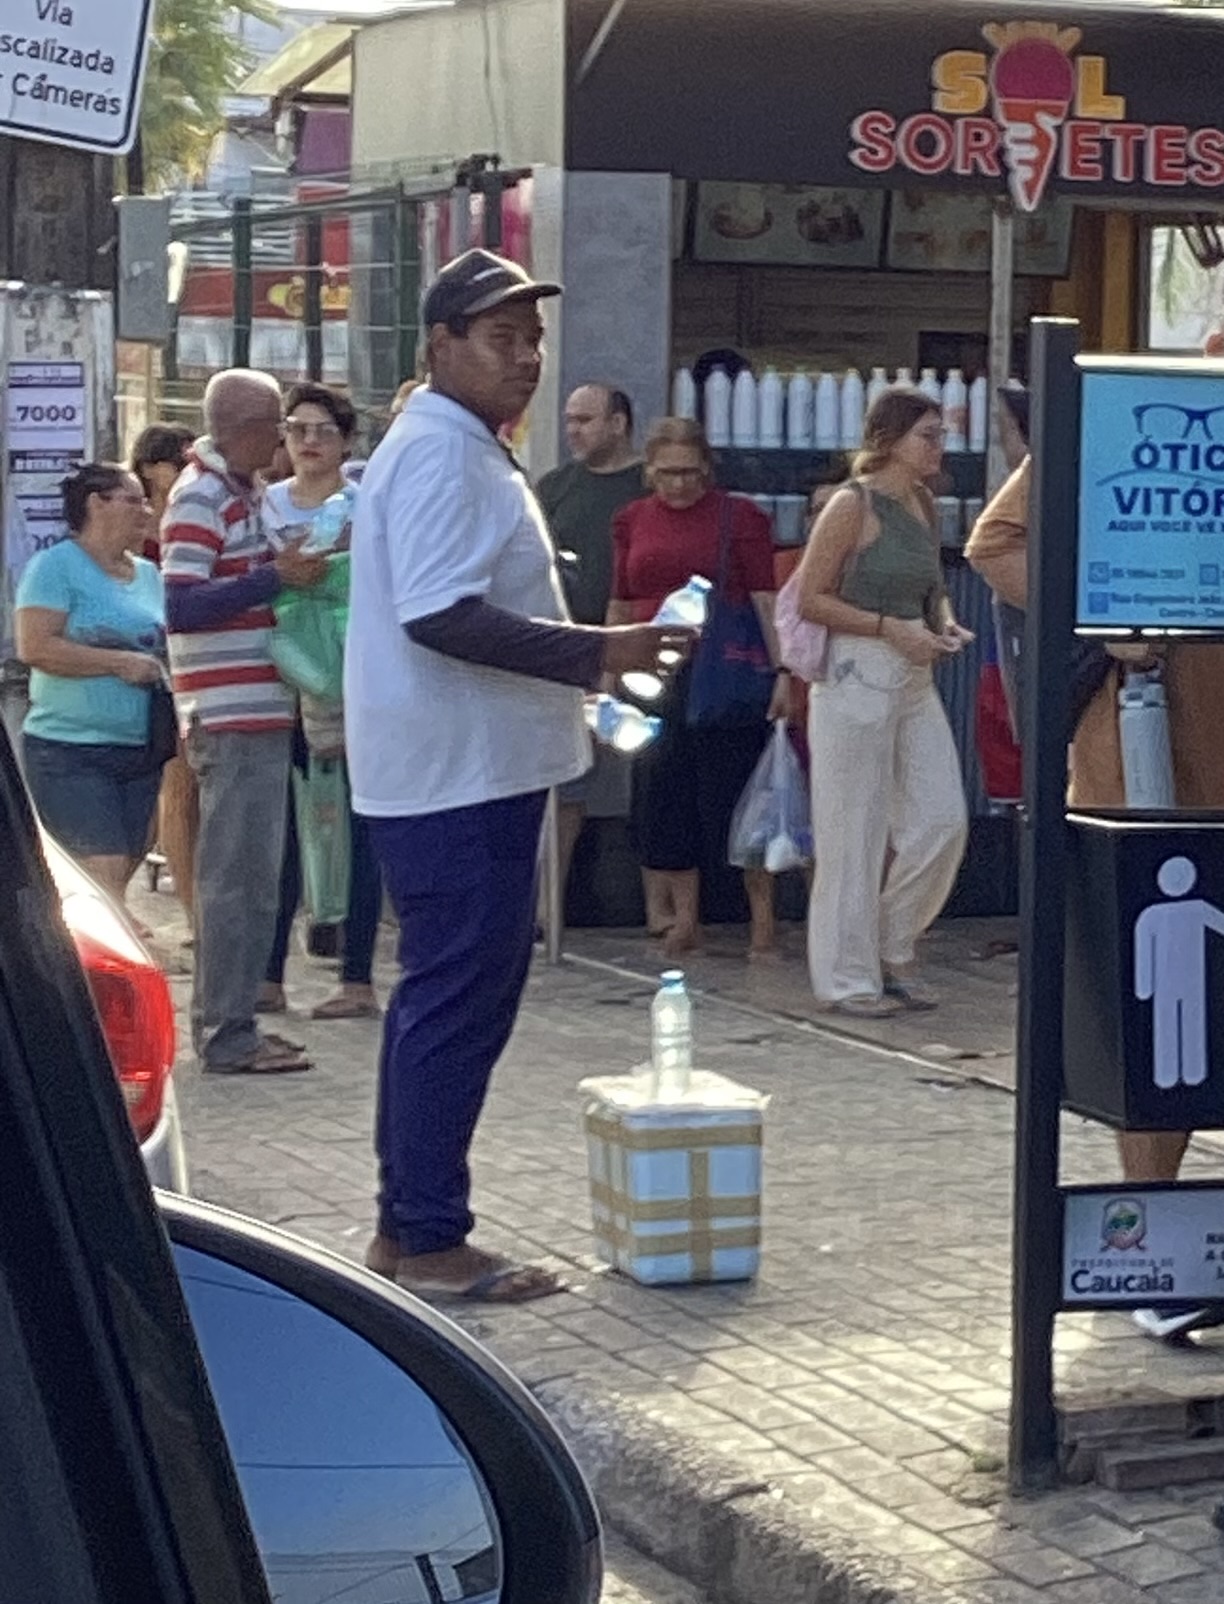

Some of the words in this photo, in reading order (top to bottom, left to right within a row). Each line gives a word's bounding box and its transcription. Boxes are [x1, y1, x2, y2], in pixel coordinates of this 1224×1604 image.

[0, 34, 115, 75] scalizada
[16, 405, 76, 422] 7000
[1071, 1267, 1174, 1294] Caucaia
